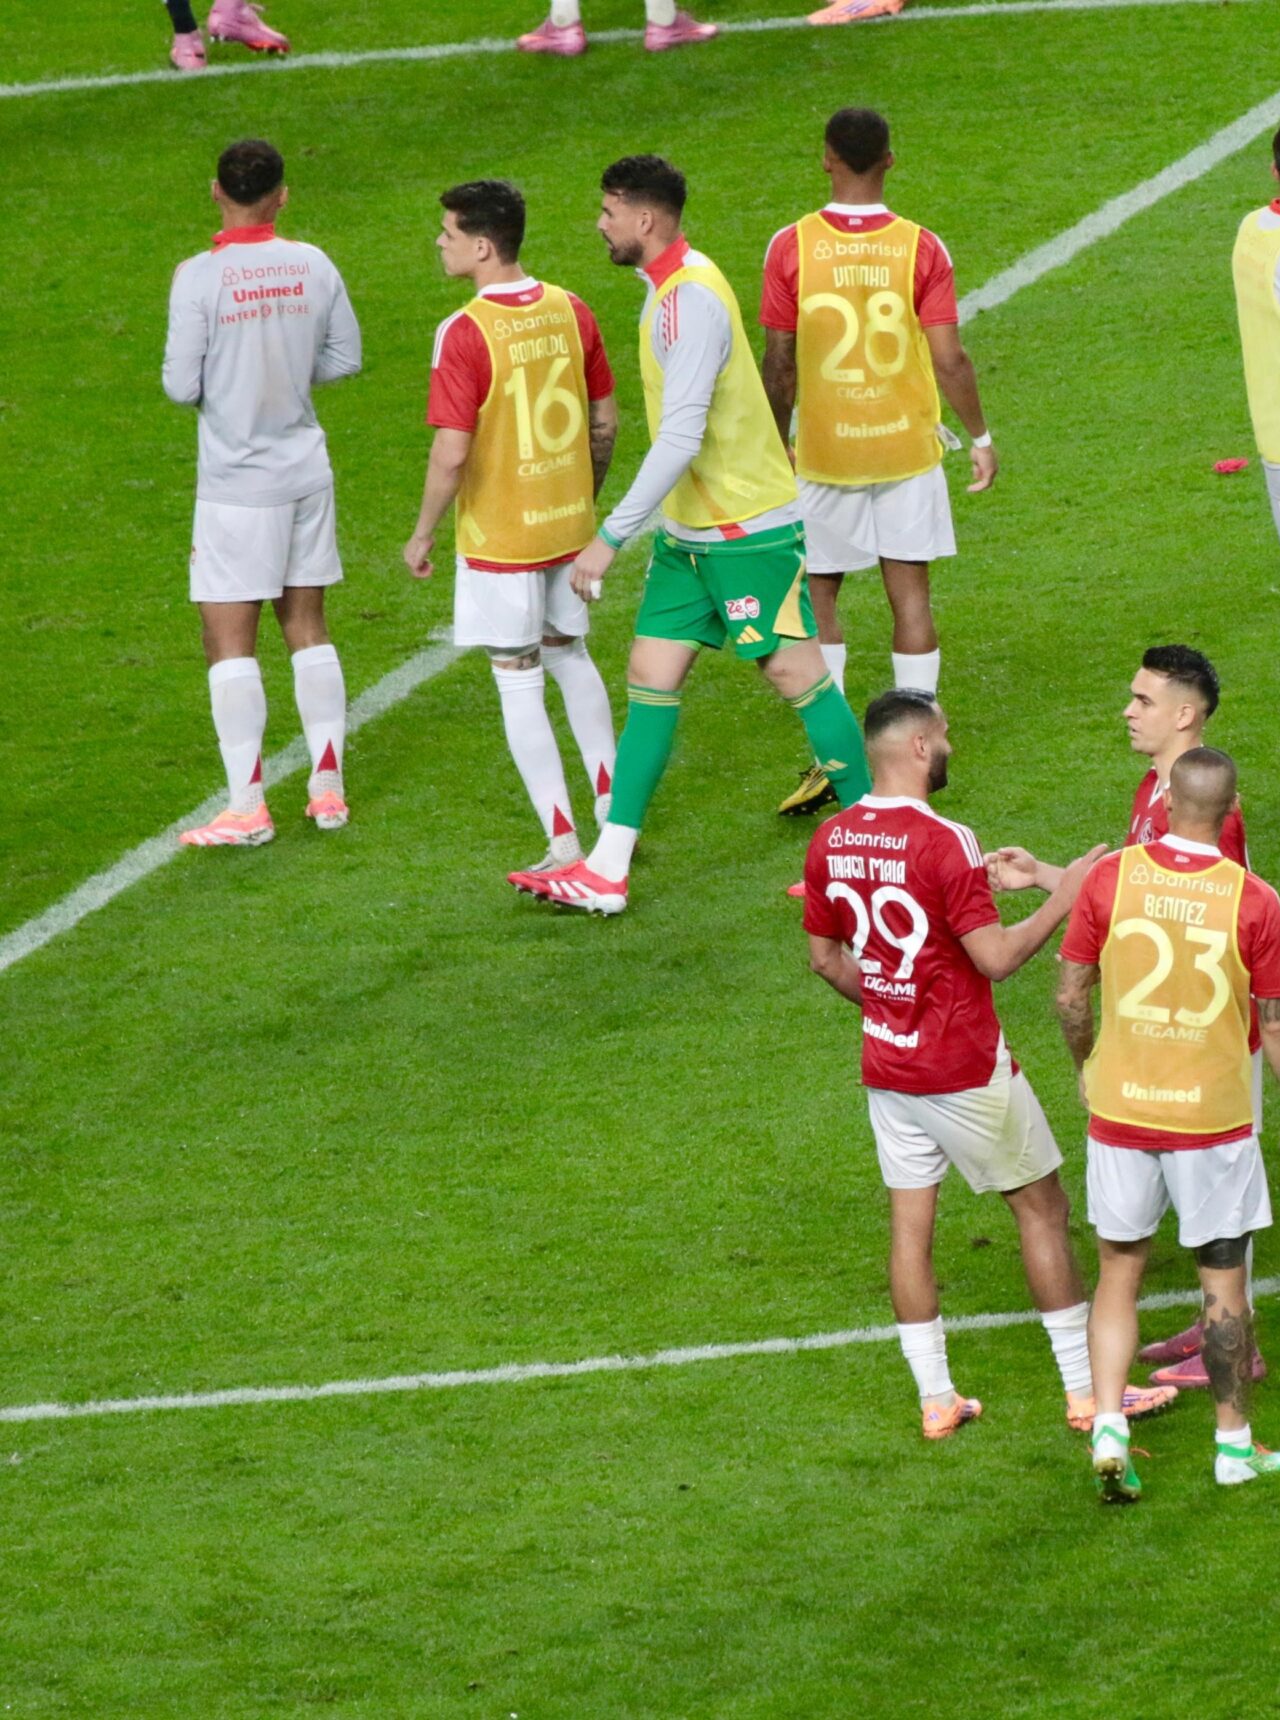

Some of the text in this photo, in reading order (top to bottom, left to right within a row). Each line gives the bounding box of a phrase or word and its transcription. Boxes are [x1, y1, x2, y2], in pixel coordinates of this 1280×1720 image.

[836, 240, 908, 258] banrisul
[242, 262, 310, 280] banrisul
[233, 282, 303, 303] Unimed
[220, 309, 257, 324] INTER
[509, 333, 569, 366] RONALDO
[801, 291, 909, 382] 28
[503, 357, 583, 459] 16
[835, 415, 909, 438] Unimed
[523, 497, 586, 525] Unimed
[845, 829, 908, 850] banrisul
[869, 857, 906, 884] MAIA
[1152, 870, 1234, 897] banrisul
[1144, 893, 1207, 926] BENITEZ
[826, 881, 929, 979] 29
[1113, 918, 1230, 1028] 23
[1131, 1022, 1209, 1043] CIGAME
[1122, 1081, 1201, 1104] Unimed
